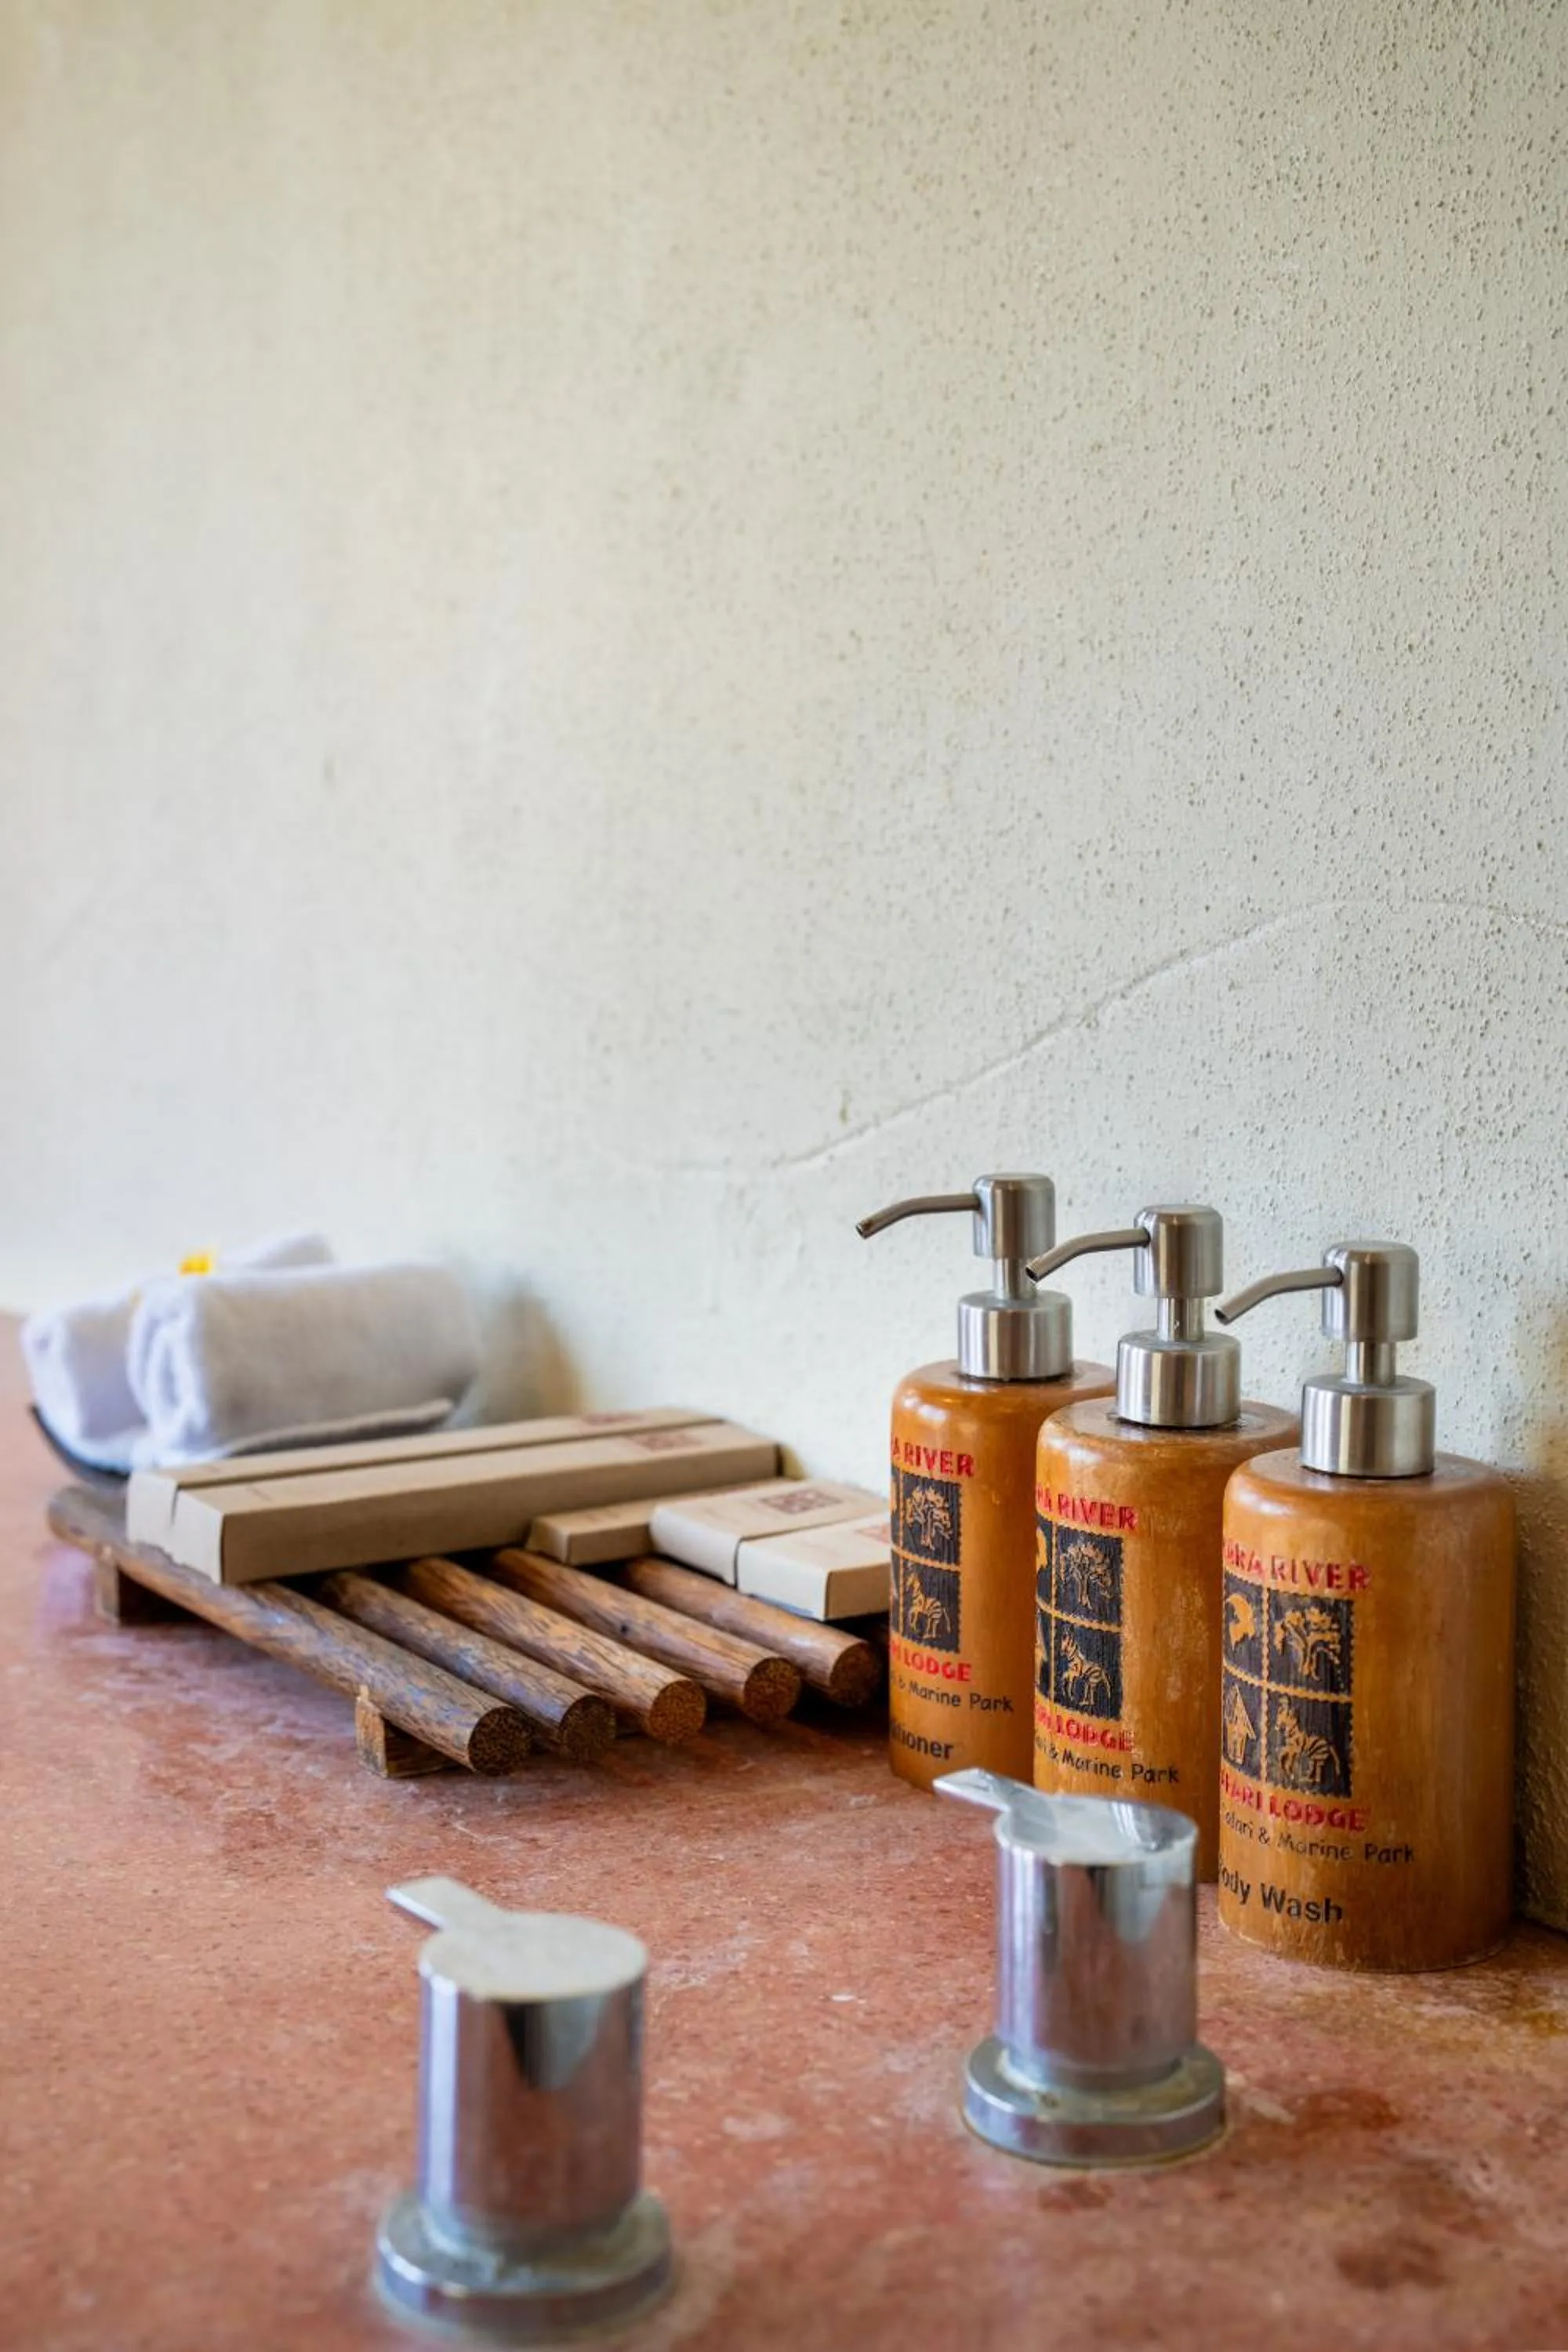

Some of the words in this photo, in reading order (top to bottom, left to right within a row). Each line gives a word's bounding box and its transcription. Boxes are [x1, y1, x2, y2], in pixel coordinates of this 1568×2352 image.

[903, 1441, 975, 1478] RIVER
[1057, 1493, 1138, 1530] RIVER
[1270, 1555, 1370, 1592] RIVER
[903, 1647, 972, 1682] LODGE
[909, 1680, 961, 1707] Marine
[970, 1690, 1014, 1714] Park
[1055, 1715, 1135, 1753] LODGE
[1062, 1748, 1122, 1780] Marine
[1131, 1762, 1180, 1784] Park
[1269, 1795, 1367, 1832] LODGE
[1258, 1825, 1271, 1846] &
[1276, 1831, 1352, 1861] Marine
[1364, 1841, 1415, 1864] Park
[1219, 1857, 1251, 1906] ody
[1260, 1882, 1342, 1923] Wash
